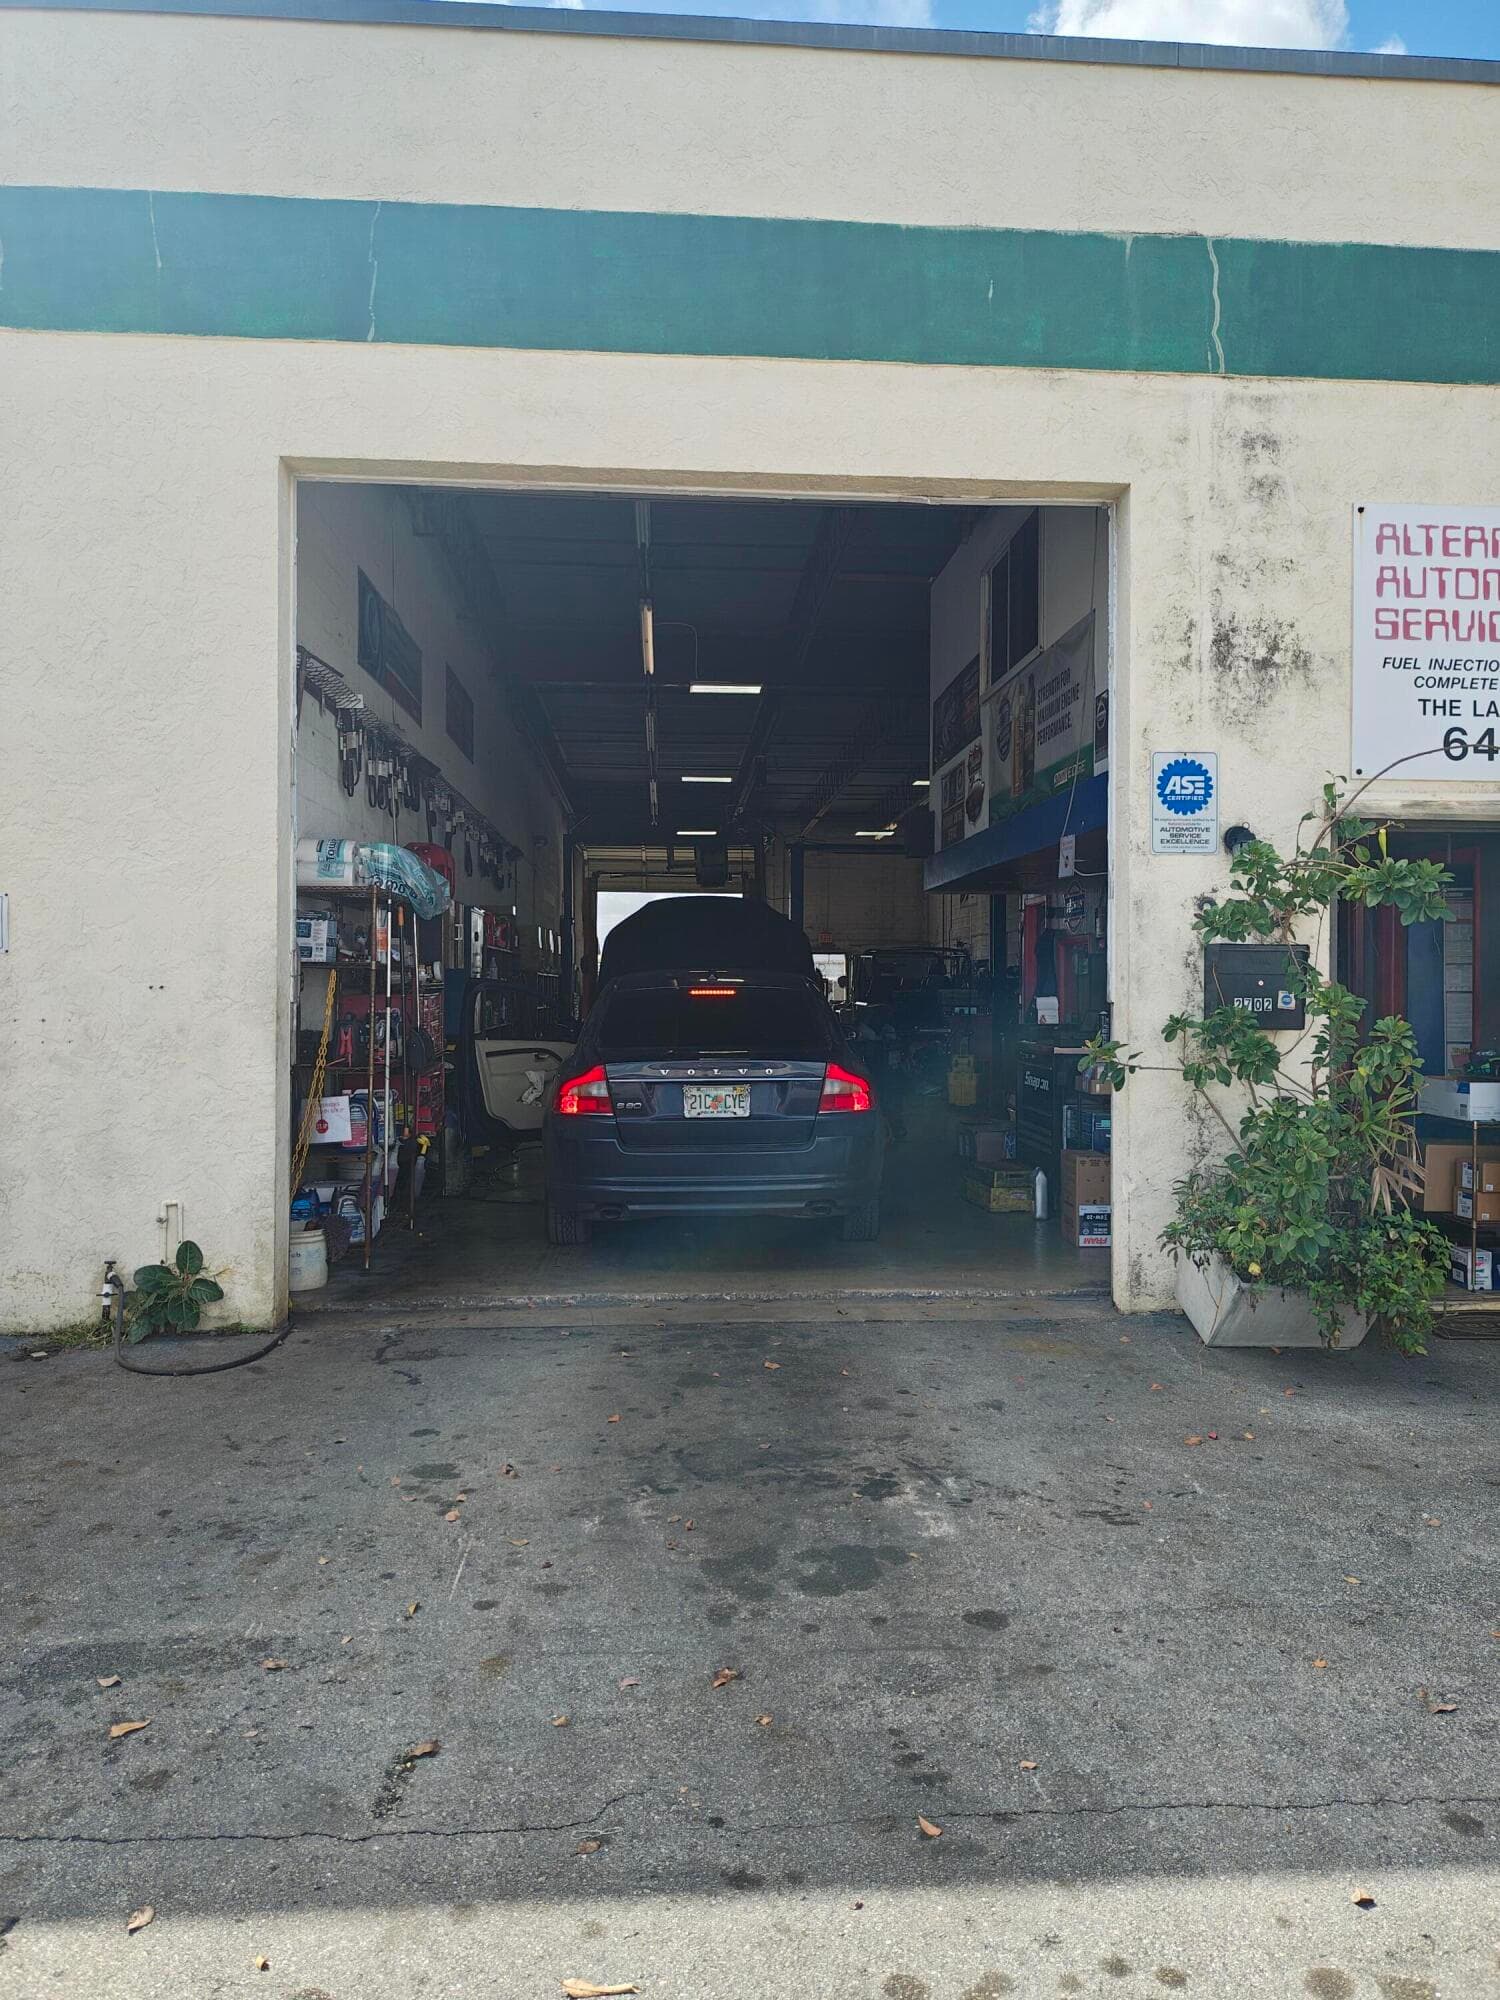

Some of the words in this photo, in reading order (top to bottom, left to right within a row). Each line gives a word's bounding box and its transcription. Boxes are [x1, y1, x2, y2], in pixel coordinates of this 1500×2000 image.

[1382, 656, 1421, 670] FUEL
[1428, 658, 1500, 672] INJECTIO
[1061, 667, 1071, 688] FOR
[1414, 676, 1499, 690] COMPLETE
[1061, 682, 1080, 710] ENGINE
[1418, 699, 1462, 717] THE
[1473, 700, 1500, 718] LA
[1443, 727, 1500, 761] 64
[1164, 775, 1205, 795] ASE
[1234, 998, 1272, 1011] 2702
[660, 1068, 773, 1076] VOLVO
[690, 1094, 711, 1110] 21C
[724, 1094, 745, 1109] CYE
[1083, 1237, 1108, 1245] FRAM
